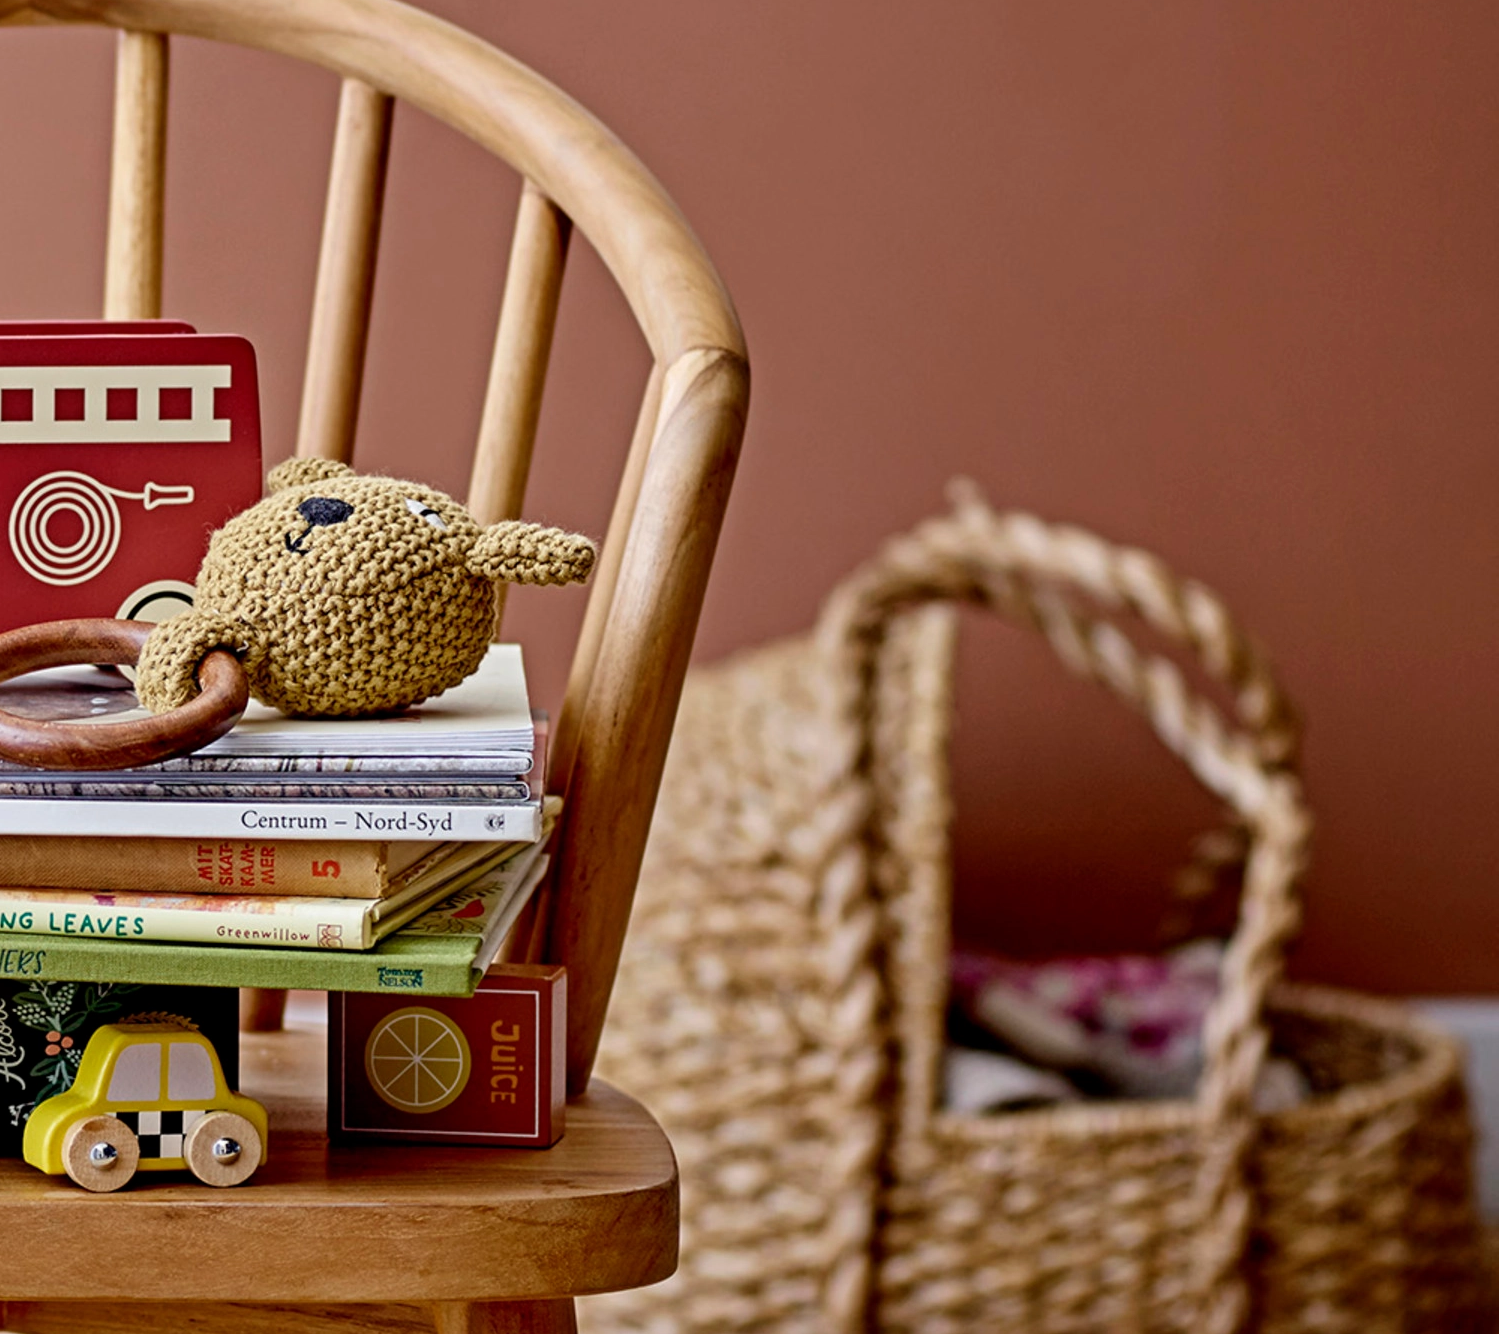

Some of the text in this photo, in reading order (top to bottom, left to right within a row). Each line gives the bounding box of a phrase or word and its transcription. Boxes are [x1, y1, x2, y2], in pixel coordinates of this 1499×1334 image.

[240, 809, 328, 830] Centrum
[355, 811, 453, 836] Nord-Syd
[196, 845, 214, 882] MIT
[260, 846, 276, 885] MER
[312, 859, 342, 880] 5
[49, 912, 145, 937] LEAVES
[216, 925, 311, 942] Greenwillow
